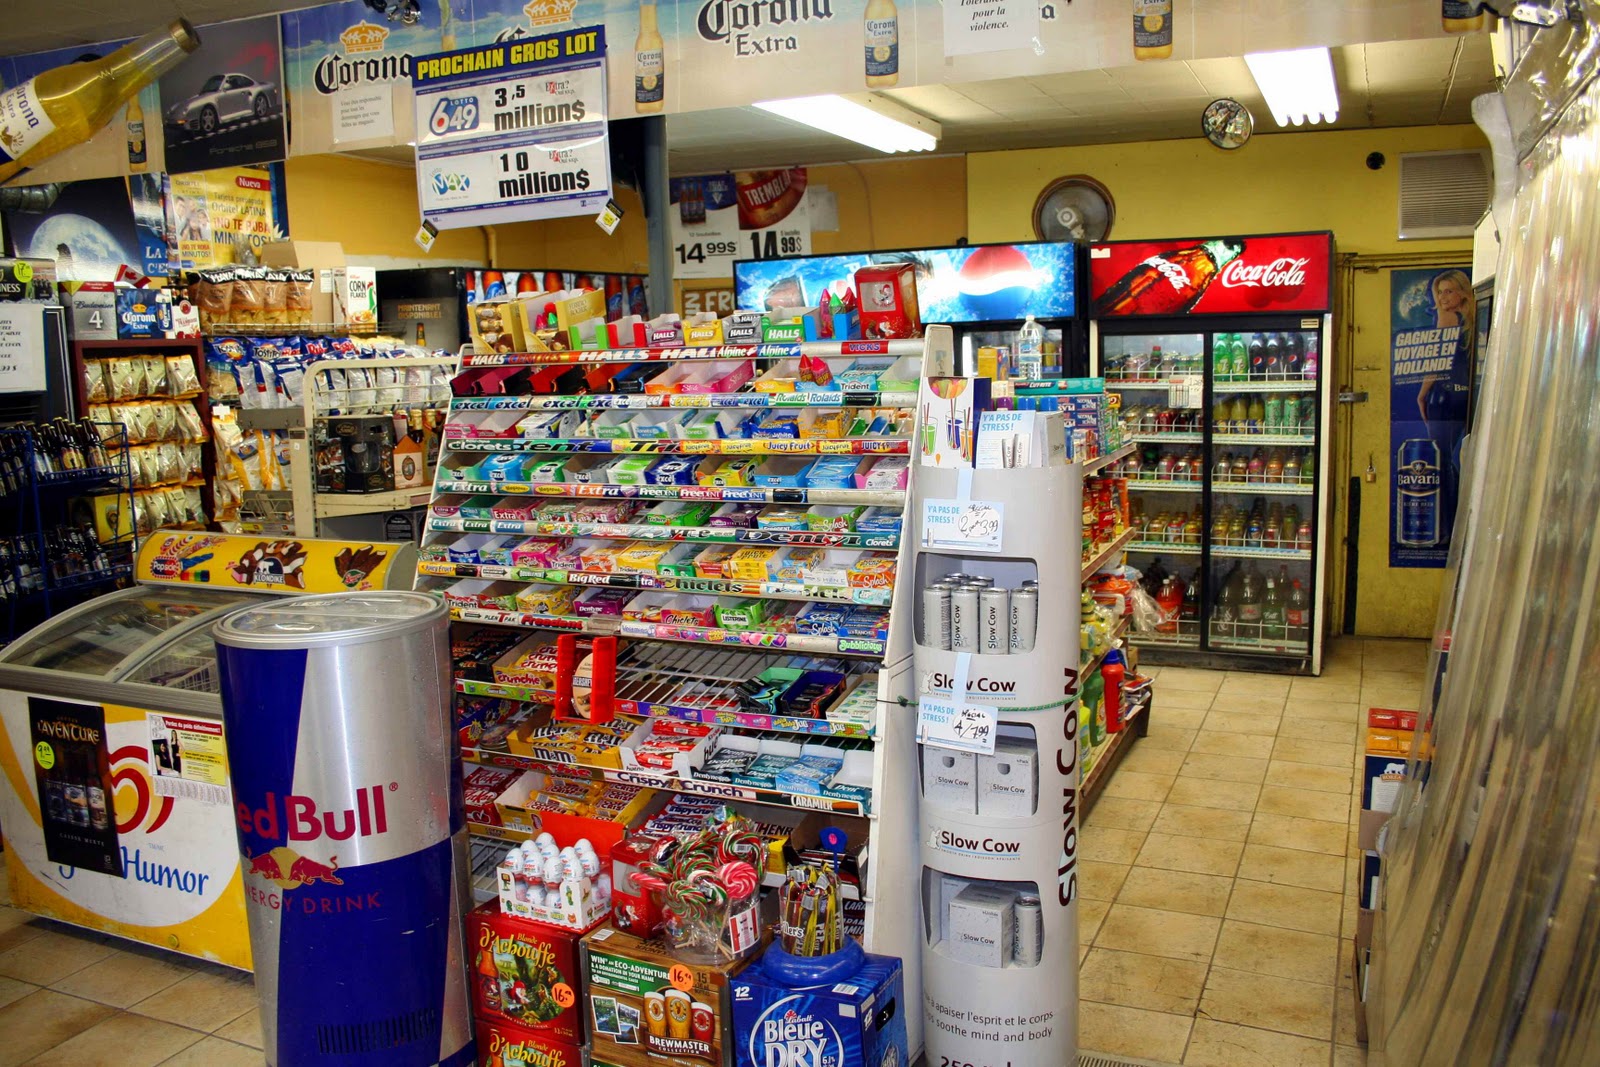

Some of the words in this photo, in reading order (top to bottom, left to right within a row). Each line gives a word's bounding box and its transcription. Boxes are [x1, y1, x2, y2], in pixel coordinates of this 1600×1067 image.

[972, 8, 994, 20] pour
[996, 7, 1006, 15] la
[970, 20, 1009, 32] violence.
[736, 33, 797, 56] Extra
[417, 48, 504, 80] PROCHAIN
[510, 38, 559, 67] GROS
[566, 32, 597, 56] LOT
[314, 53, 412, 95] Corona
[15, 80, 40, 128] orona
[432, 173, 471, 195] MAX
[233, 219, 243, 230] TE
[214, 231, 271, 248] MINTOS!
[145, 246, 161, 259] LA
[675, 243, 706, 264] 14
[1221, 257, 1311, 288] Coca-Cola
[349, 281, 367, 292] CORN
[88, 310, 104, 329] 4
[122, 312, 156, 324] Corona
[132, 322, 149, 330] Extra
[653, 331, 675, 340] HALLS
[691, 330, 714, 338] HALLS
[730, 328, 754, 338] HALLS
[768, 329, 800, 339] HALLS
[1395, 328, 1442, 347] GAGNEZ
[1442, 326, 1460, 341] UN
[470, 355, 506, 366] HALLS
[578, 350, 650, 361] HALLS
[717, 346, 747, 358] Alpine
[757, 345, 790, 356] Alpine
[849, 343, 880, 351] VICKS
[1394, 343, 1440, 361] VOYAGE
[1440, 341, 1458, 356] EN
[1393, 357, 1454, 376] HOLLANDE
[840, 383, 870, 391] Trident
[454, 398, 491, 410] excel
[495, 397, 534, 409] excel
[543, 396, 583, 408] excel
[587, 396, 612, 408] exc
[775, 393, 807, 402] Rolaids
[810, 393, 841, 402] Rolaids
[983, 413, 997, 422] Y'A
[998, 413, 1010, 421] PAS
[1012, 413, 1022, 421] DE
[982, 423, 1008, 432] STRESS
[448, 440, 512, 451] Clorets
[766, 443, 788, 451] Juicy
[789, 442, 811, 450] Fruit
[1397, 473, 1440, 485] Bavaria
[452, 482, 488, 493] Extra
[578, 485, 619, 497] Extra
[493, 510, 516, 520] Extra
[927, 505, 937, 513] Y'A
[938, 506, 951, 514] PAS
[823, 517, 848, 531] Splash
[927, 515, 951, 524] STRESS
[497, 522, 521, 530] Extra
[865, 539, 894, 547] Clorets
[254, 574, 284, 583] KLONDIKE
[863, 575, 889, 587] Splash
[449, 600, 478, 609] Trident
[665, 615, 699, 626] Chiclets
[988, 606, 996, 626] Cow
[811, 623, 837, 636] Splash
[988, 628, 996, 649] Slow
[839, 640, 883, 653] Bubblicious
[978, 677, 1016, 692] Cow
[923, 703, 933, 712] Y'A
[933, 704, 946, 713] PAS
[946, 706, 955, 715] DE
[922, 714, 946, 723] STRESS
[938, 776, 954, 785] Slow
[954, 778, 969, 787] Cow
[618, 771, 670, 788] Crispy
[681, 779, 743, 797] Crunch
[791, 795, 833, 811] CARAMILK
[992, 783, 1009, 792] Slow
[1010, 785, 1026, 794] Cow
[235, 791, 280, 841] ed
[284, 784, 388, 842] Bull
[941, 830, 979, 850] Slow
[982, 838, 1020, 853] Cow
[120, 845, 209, 896] Humor
[303, 892, 382, 914] DRINK
[517, 933, 538, 945] Blonde
[963, 933, 980, 942] Slow
[980, 936, 995, 945] Cow
[696, 972, 707, 984] 15
[734, 986, 750, 998] 12
[935, 1001, 965, 1020] apaiser
[968, 1011, 1002, 1027] l'esprit
[1005, 1017, 1014, 1026] et
[1018, 1016, 1026, 1026] le
[1029, 1010, 1053, 1025] corps
[764, 1019, 824, 1043] Bleue
[936, 1019, 967, 1037] soothe
[971, 1031, 999, 1041] mind
[1003, 1032, 1024, 1042] and
[1028, 1026, 1053, 1041] body
[528, 1040, 549, 1051] Blonde
[649, 1035, 710, 1053] BREWMASTER
[764, 1037, 829, 1067] DRY
